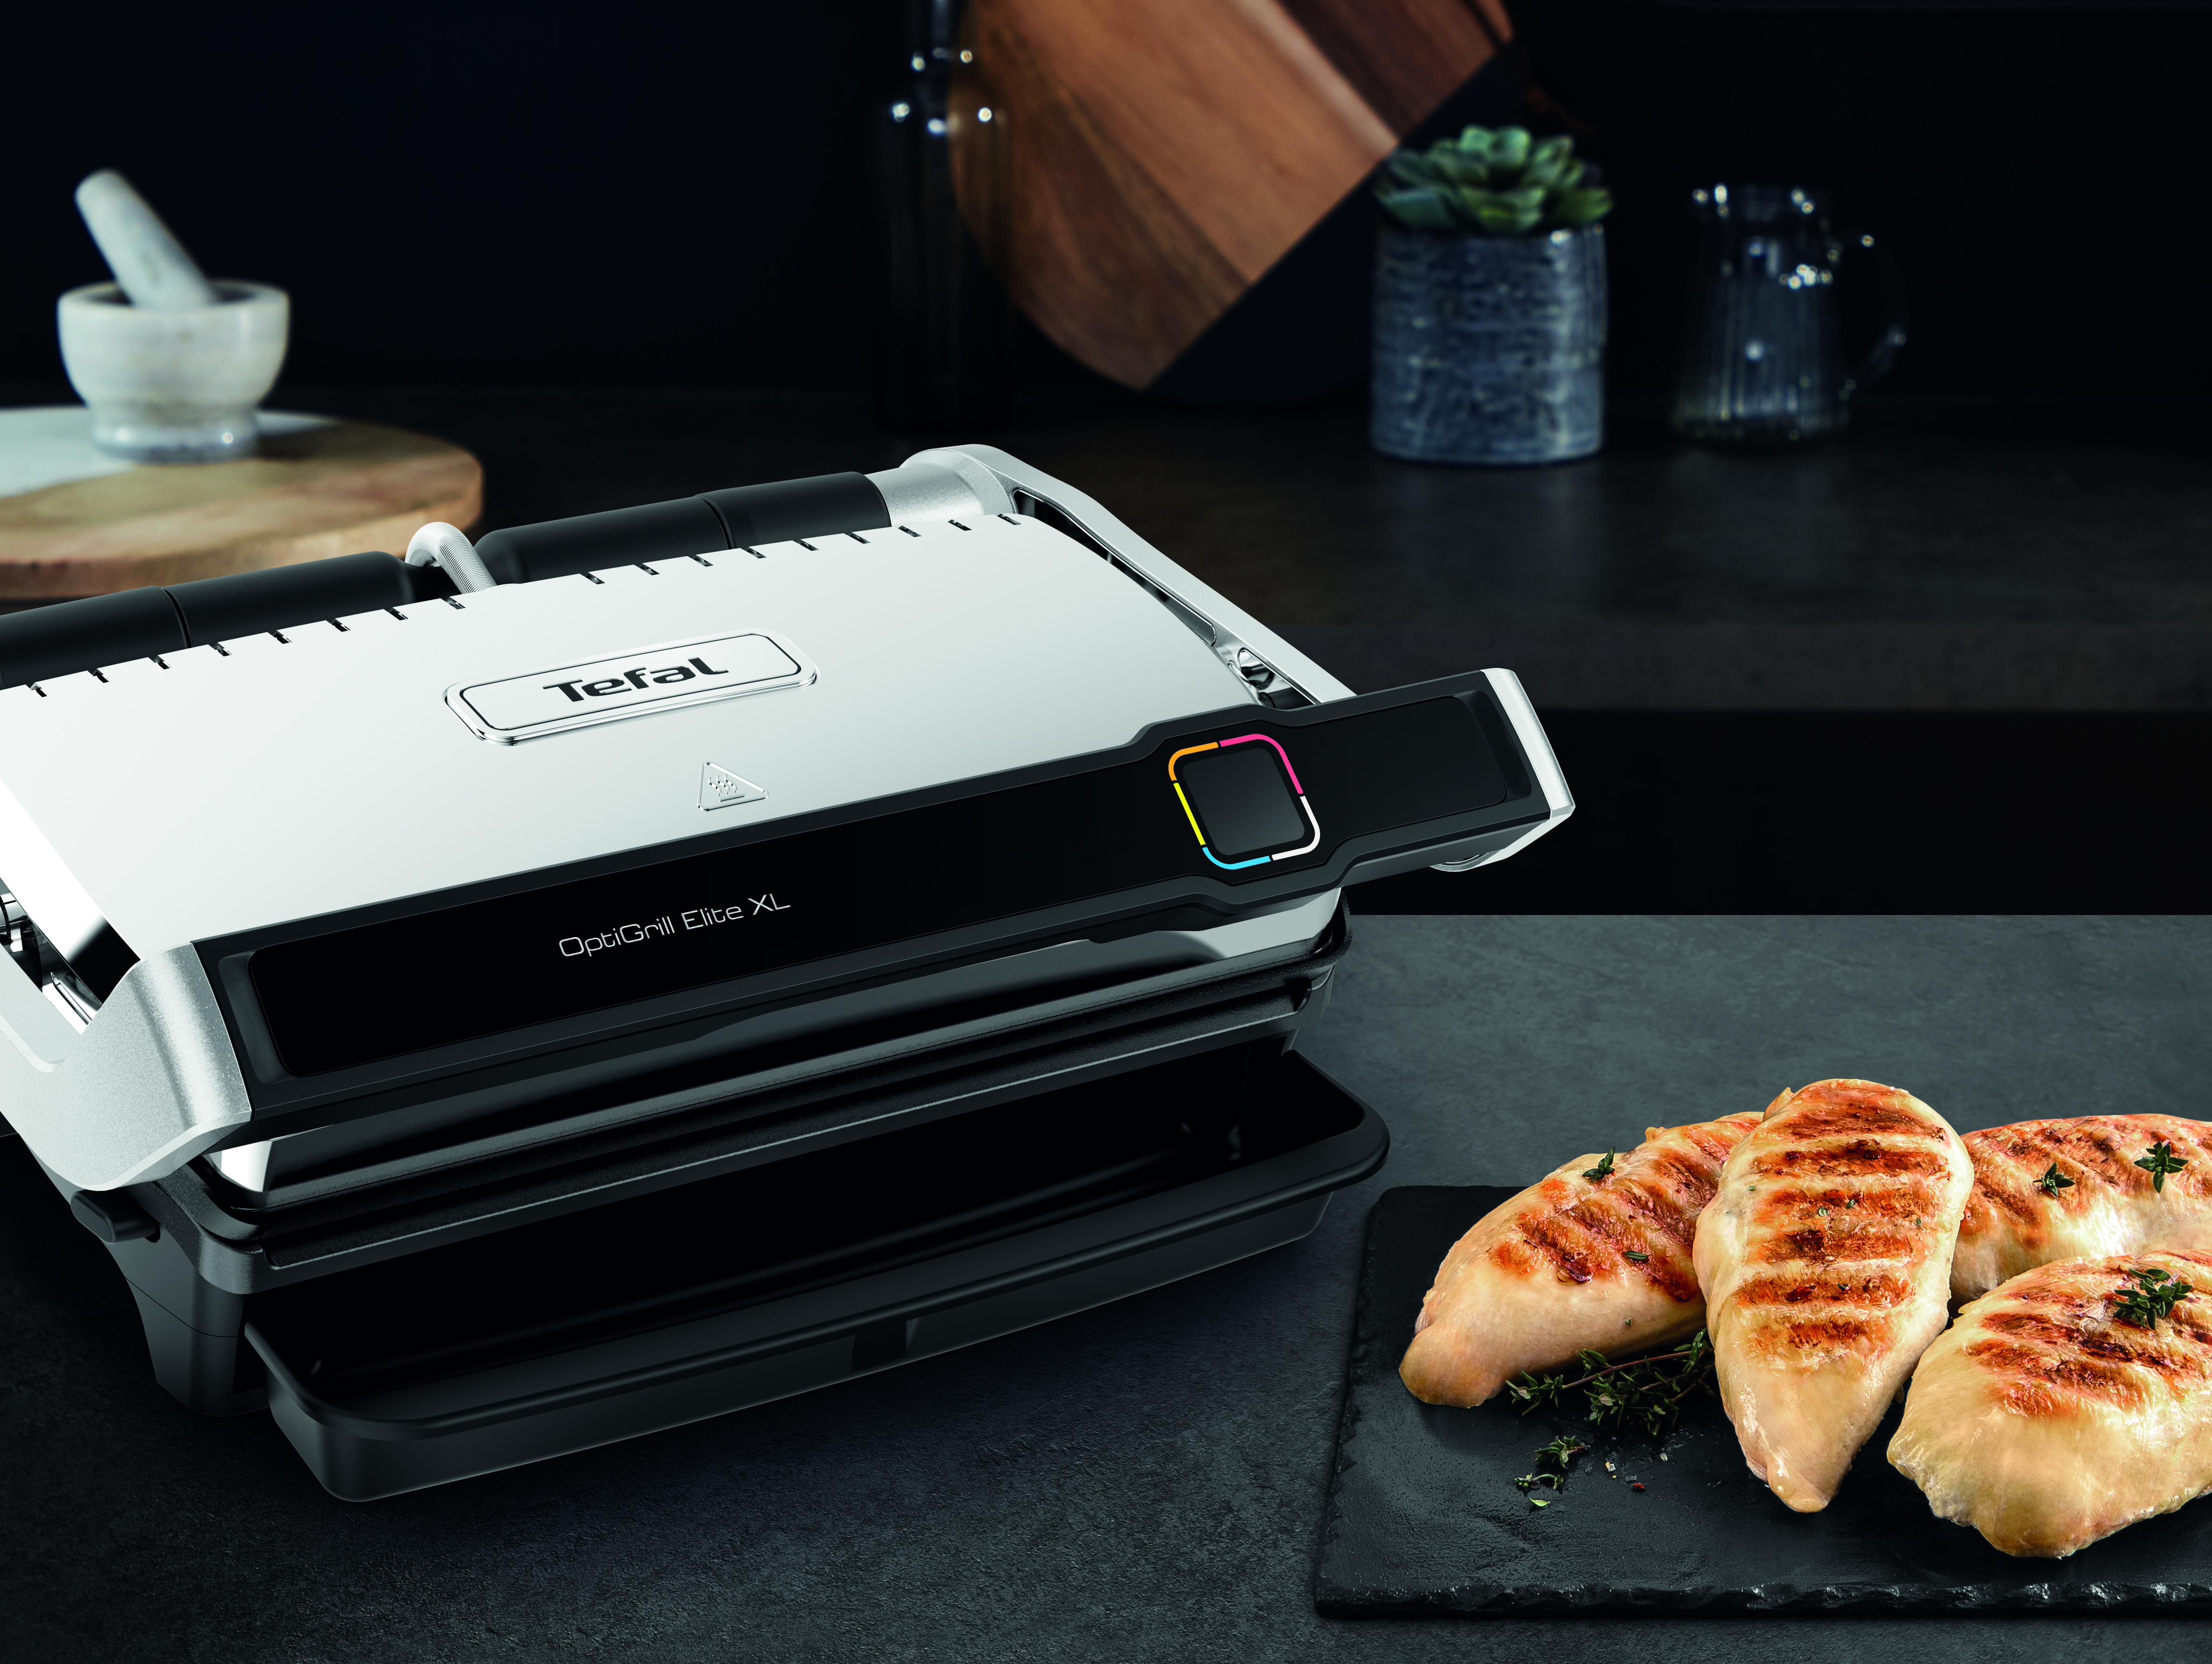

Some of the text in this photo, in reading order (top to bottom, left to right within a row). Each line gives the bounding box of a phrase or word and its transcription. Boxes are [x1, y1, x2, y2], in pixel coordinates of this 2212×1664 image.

[542, 657, 729, 702] Tefal
[559, 893, 791, 957] OptiGrill Elite XL
